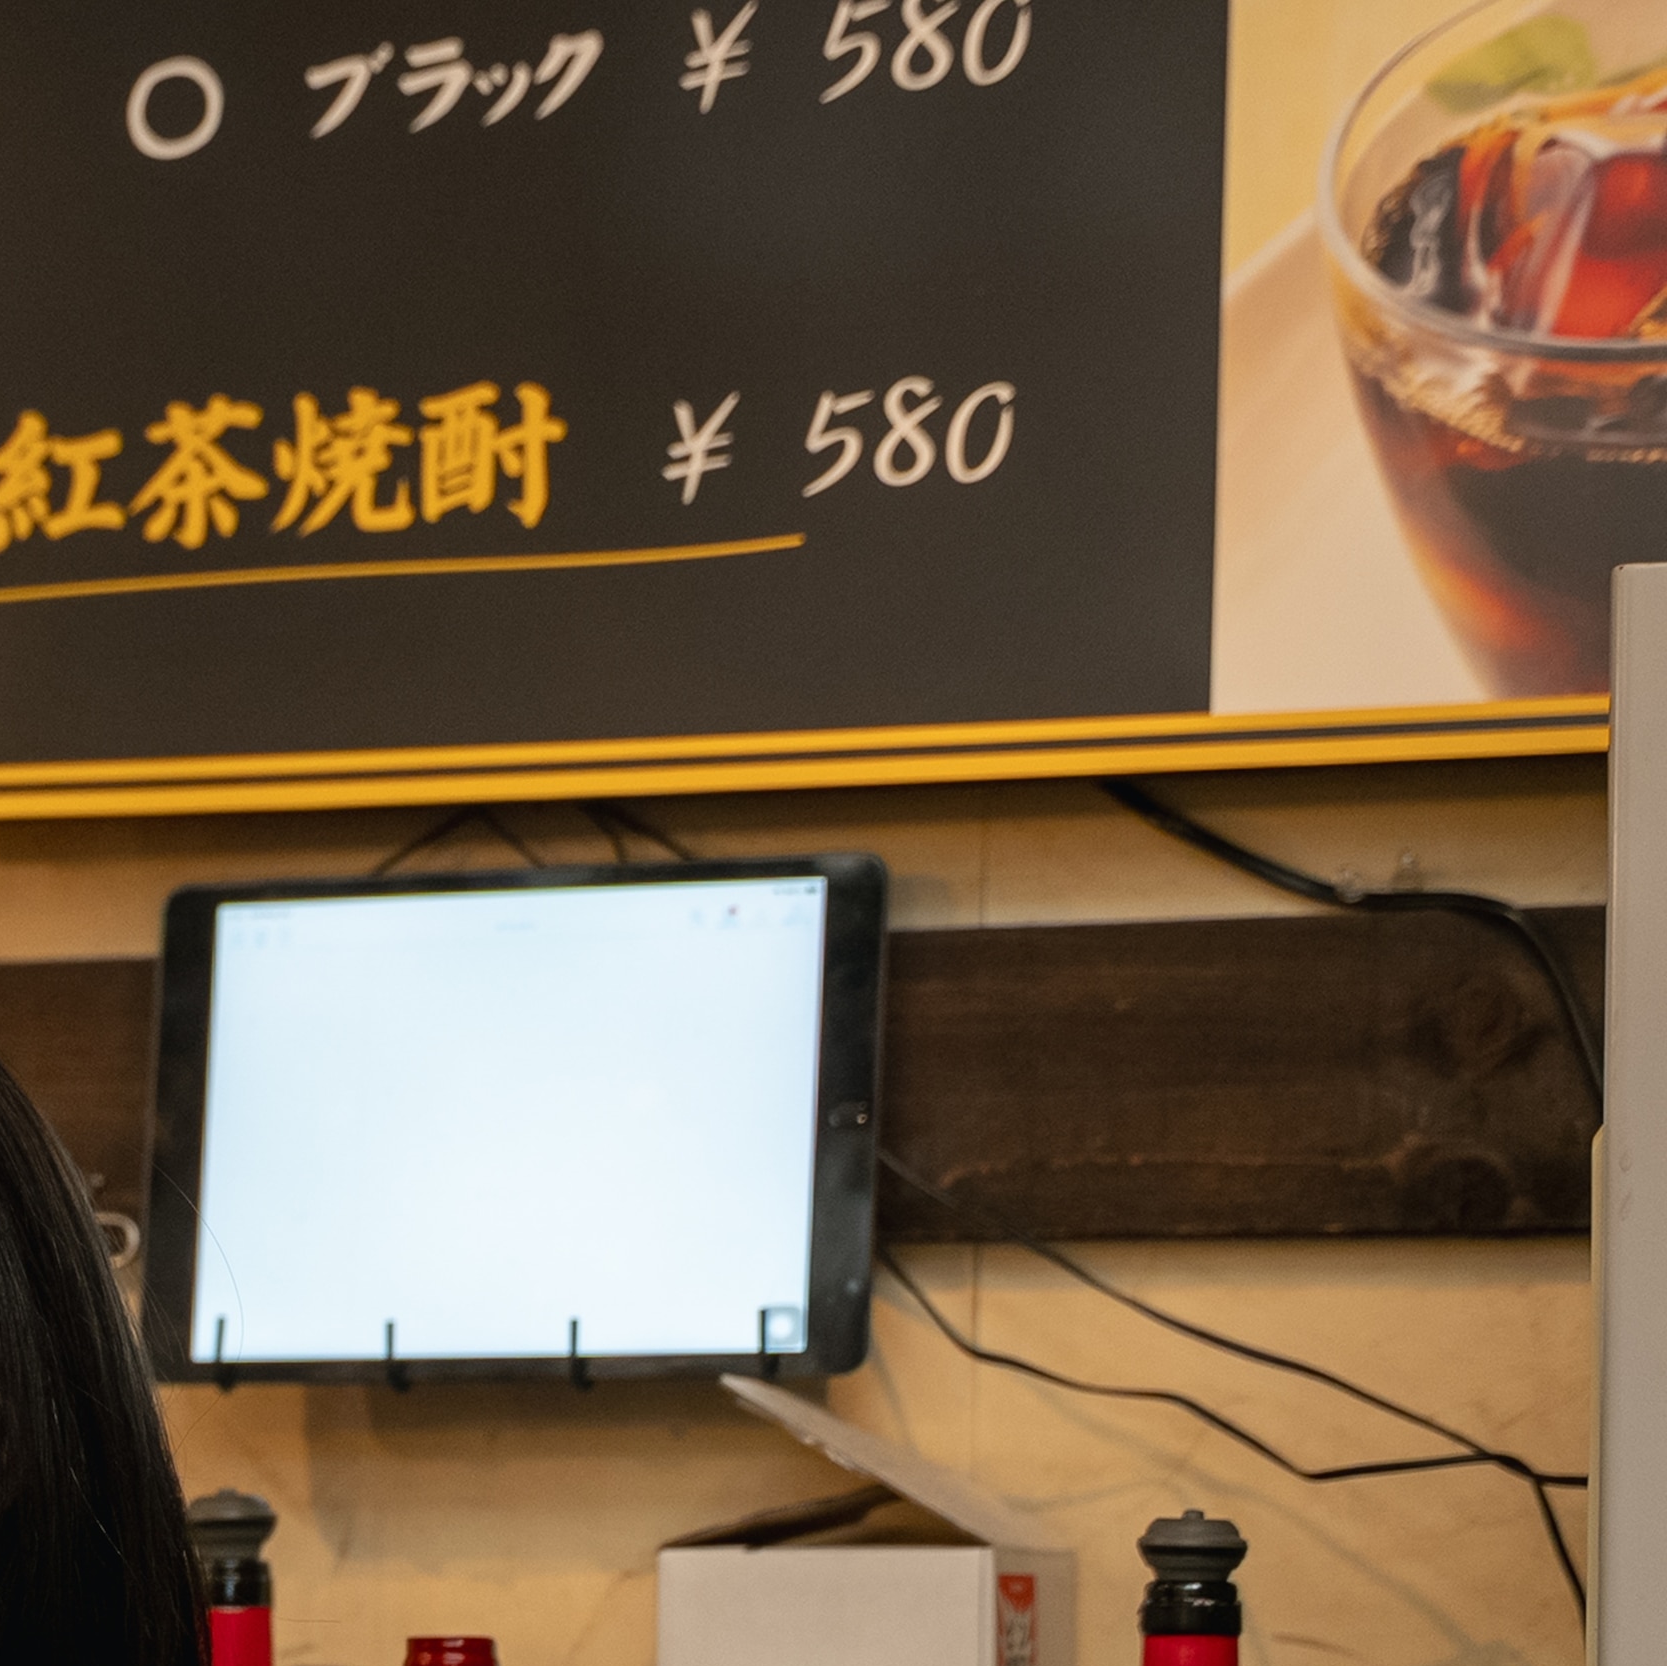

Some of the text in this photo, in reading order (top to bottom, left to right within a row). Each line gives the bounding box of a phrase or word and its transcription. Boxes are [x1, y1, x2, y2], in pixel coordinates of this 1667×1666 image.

[304, 0, 1033, 139] ブラック ¥ 580
[661, 390, 741, 505] ¥
[800, 374, 1017, 498] 580
